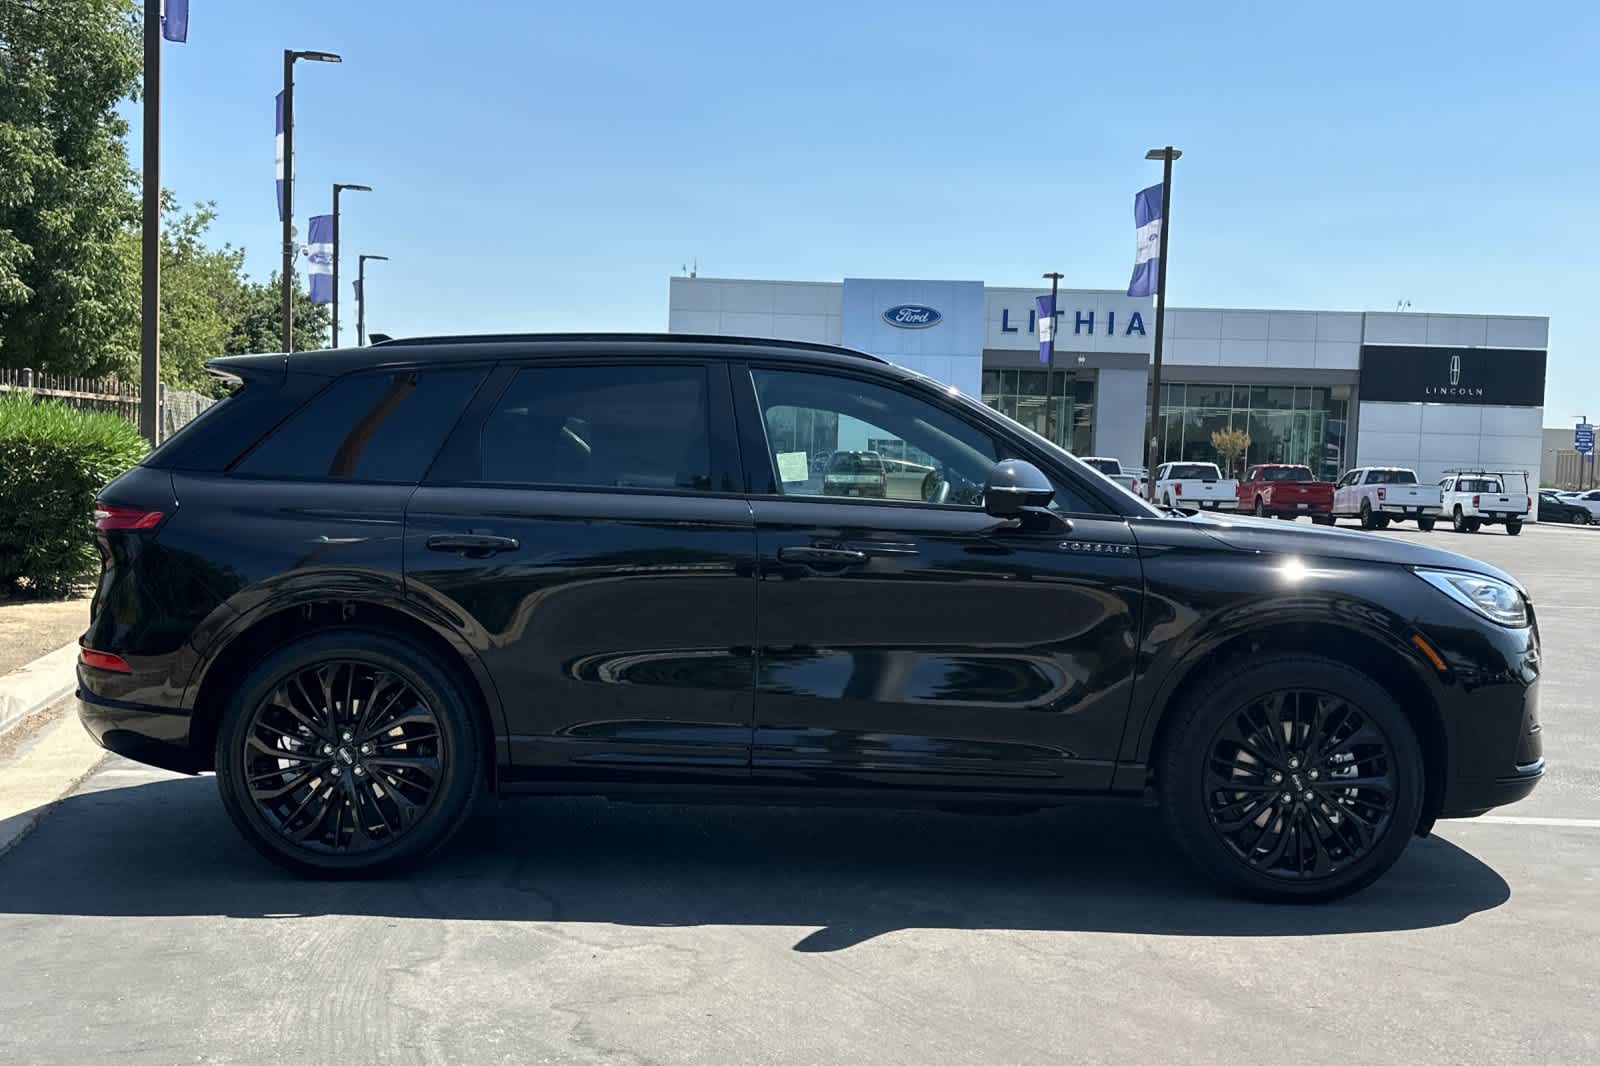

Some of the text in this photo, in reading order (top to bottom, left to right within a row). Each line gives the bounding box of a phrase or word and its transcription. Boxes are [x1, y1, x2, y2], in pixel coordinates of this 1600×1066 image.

[896, 308, 929, 323] Ford
[1425, 386, 1483, 396] LINCOLN
[1058, 541, 1131, 554] CORSAIR
